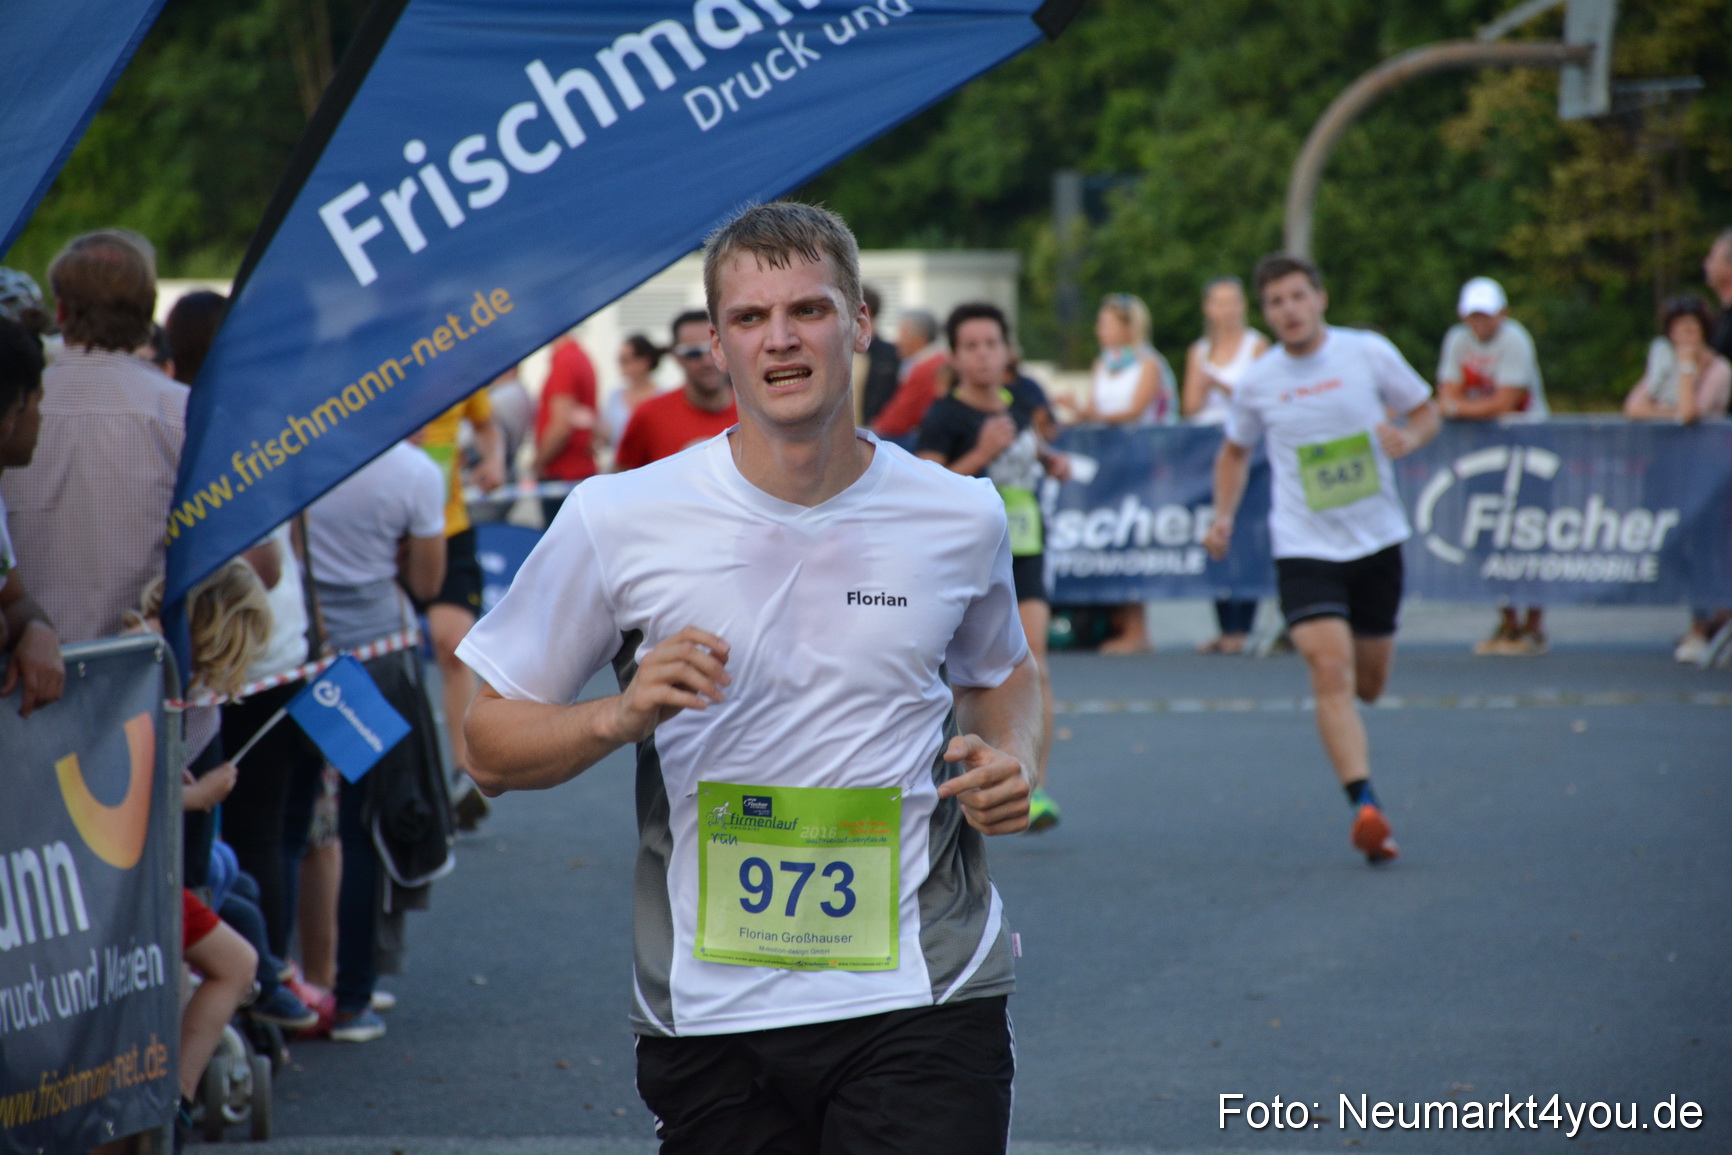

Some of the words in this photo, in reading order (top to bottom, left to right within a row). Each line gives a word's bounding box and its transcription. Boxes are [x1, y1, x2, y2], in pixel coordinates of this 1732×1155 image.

[683, 30, 822, 132] Druck
[1462, 487, 1681, 551] Fischer
[1481, 552, 1660, 582] AUTOMOBILE
[847, 591, 907, 607] Florian
[730, 812, 799, 831] firmenlauf
[800, 826, 837, 839] 2016
[739, 856, 857, 919] 973
[739, 927, 778, 942] Florian
[781, 931, 853, 944] Großhauser
[52, 947, 99, 1019] und
